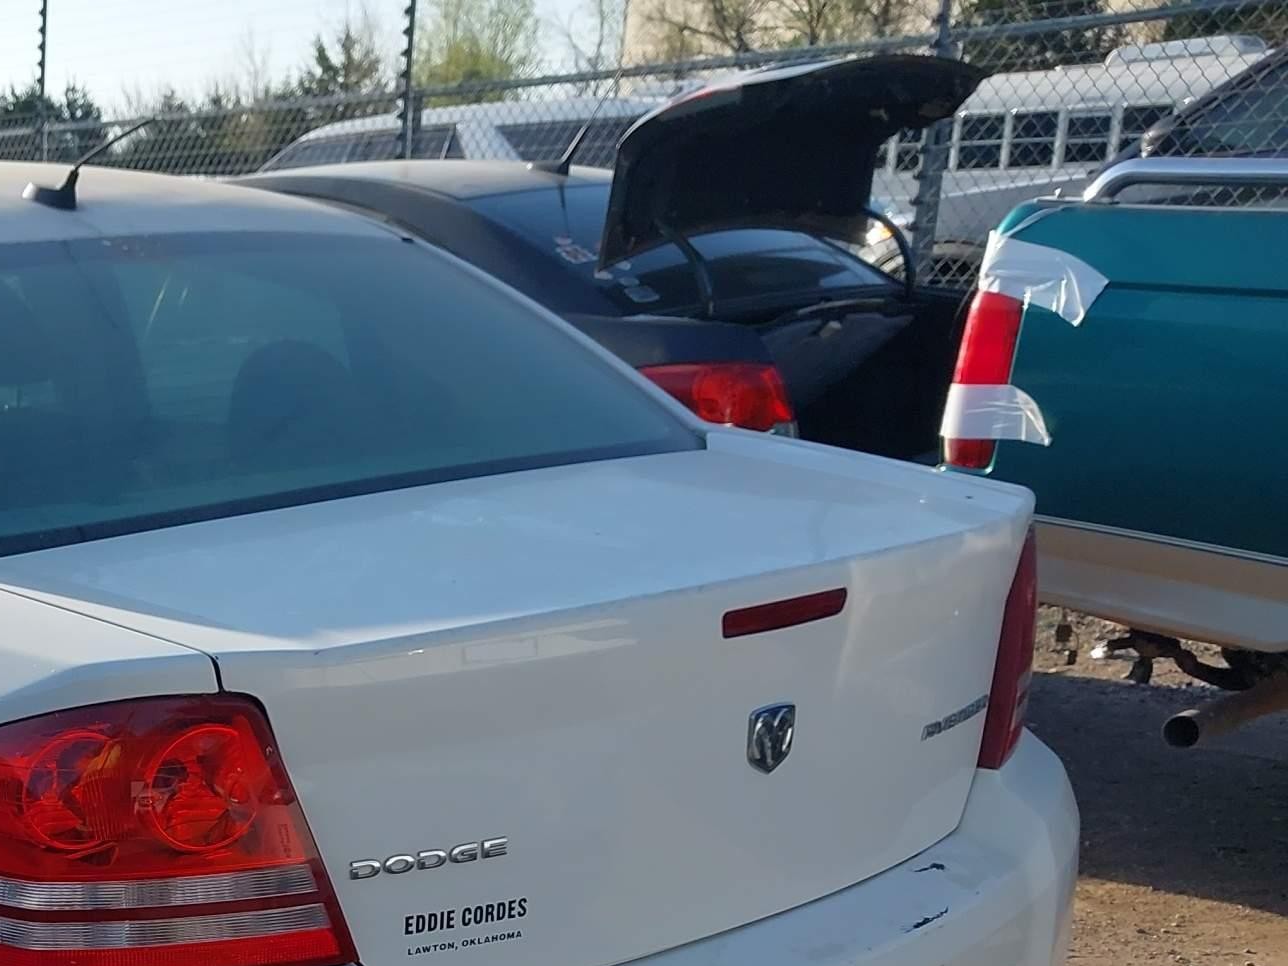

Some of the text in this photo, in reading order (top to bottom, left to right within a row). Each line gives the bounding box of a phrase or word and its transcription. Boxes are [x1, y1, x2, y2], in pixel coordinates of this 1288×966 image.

[349, 835, 508, 880] DODGE
[404, 898, 528, 936] EDDIE CORDES
[407, 930, 522, 956] LAWTON, OKLAHOMA
